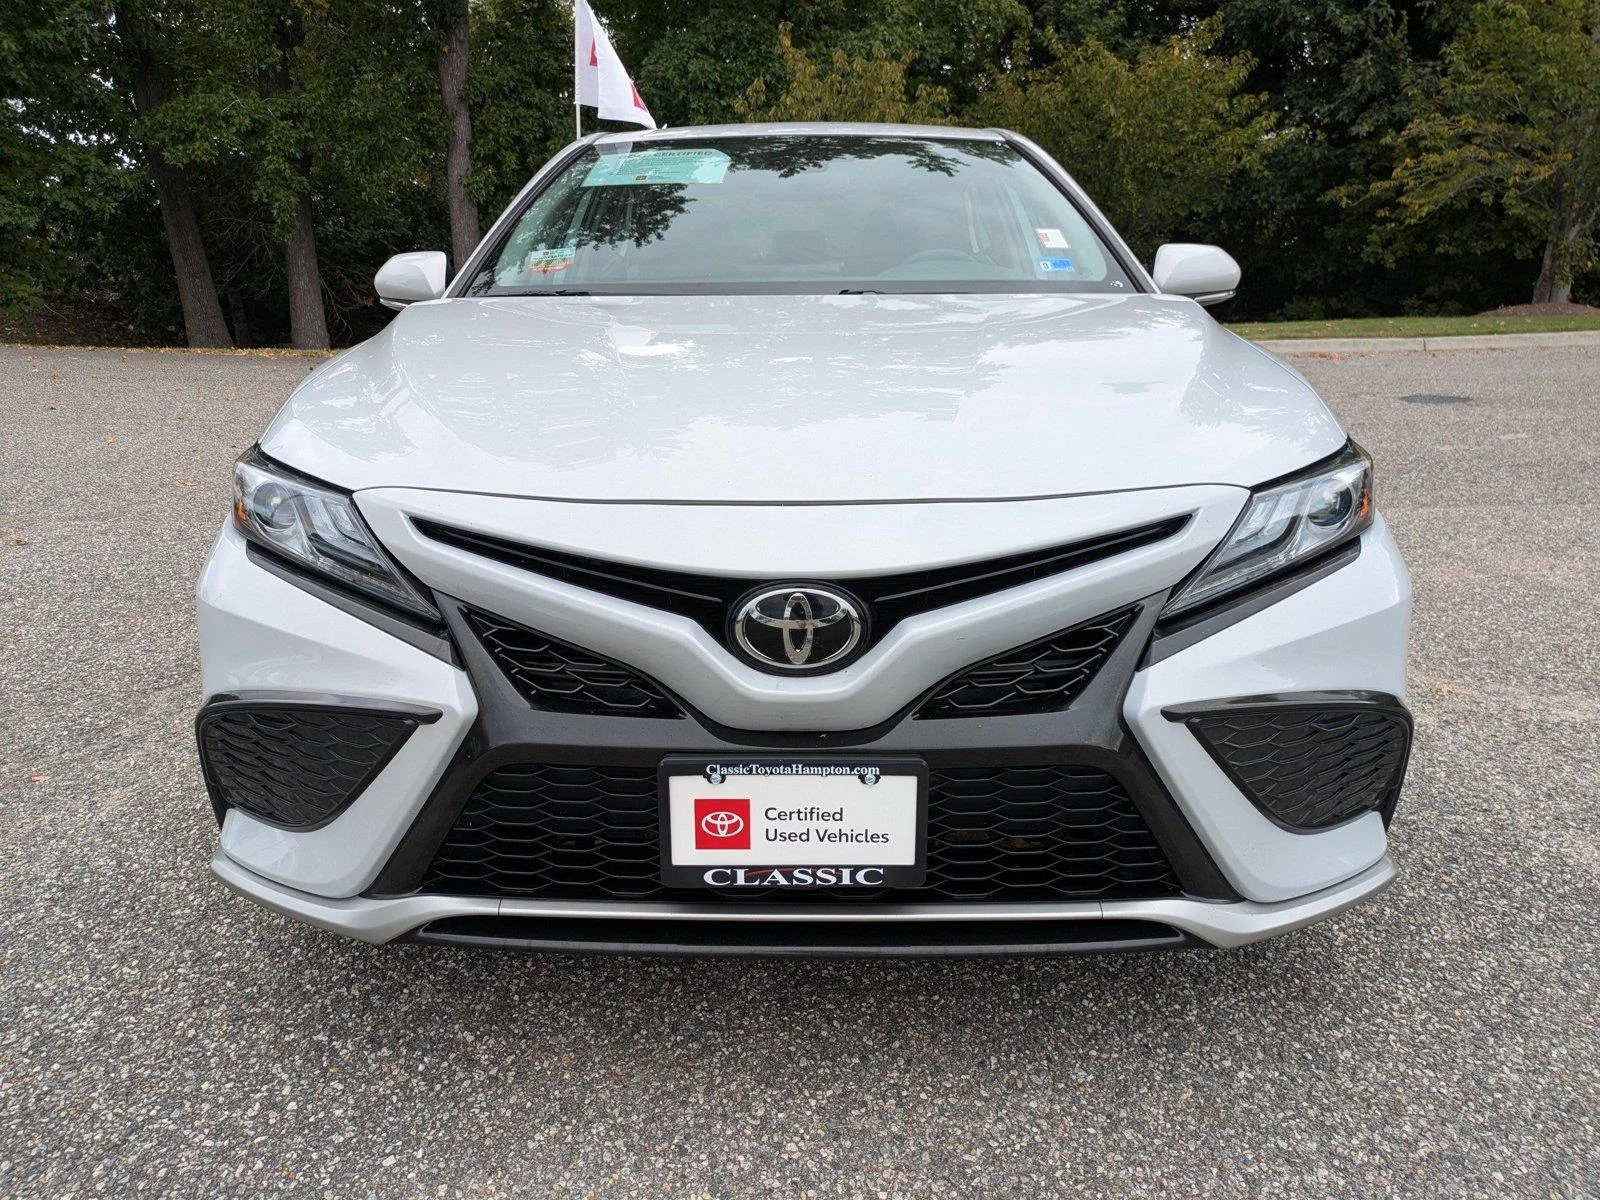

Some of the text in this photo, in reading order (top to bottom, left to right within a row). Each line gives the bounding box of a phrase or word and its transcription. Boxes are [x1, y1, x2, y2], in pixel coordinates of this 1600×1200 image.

[705, 764, 880, 776] ClassicToyotaHampton.com
[765, 807, 844, 821] Certified
[765, 828, 890, 843] Used Vehicles
[703, 868, 884, 885] CLASSIC
